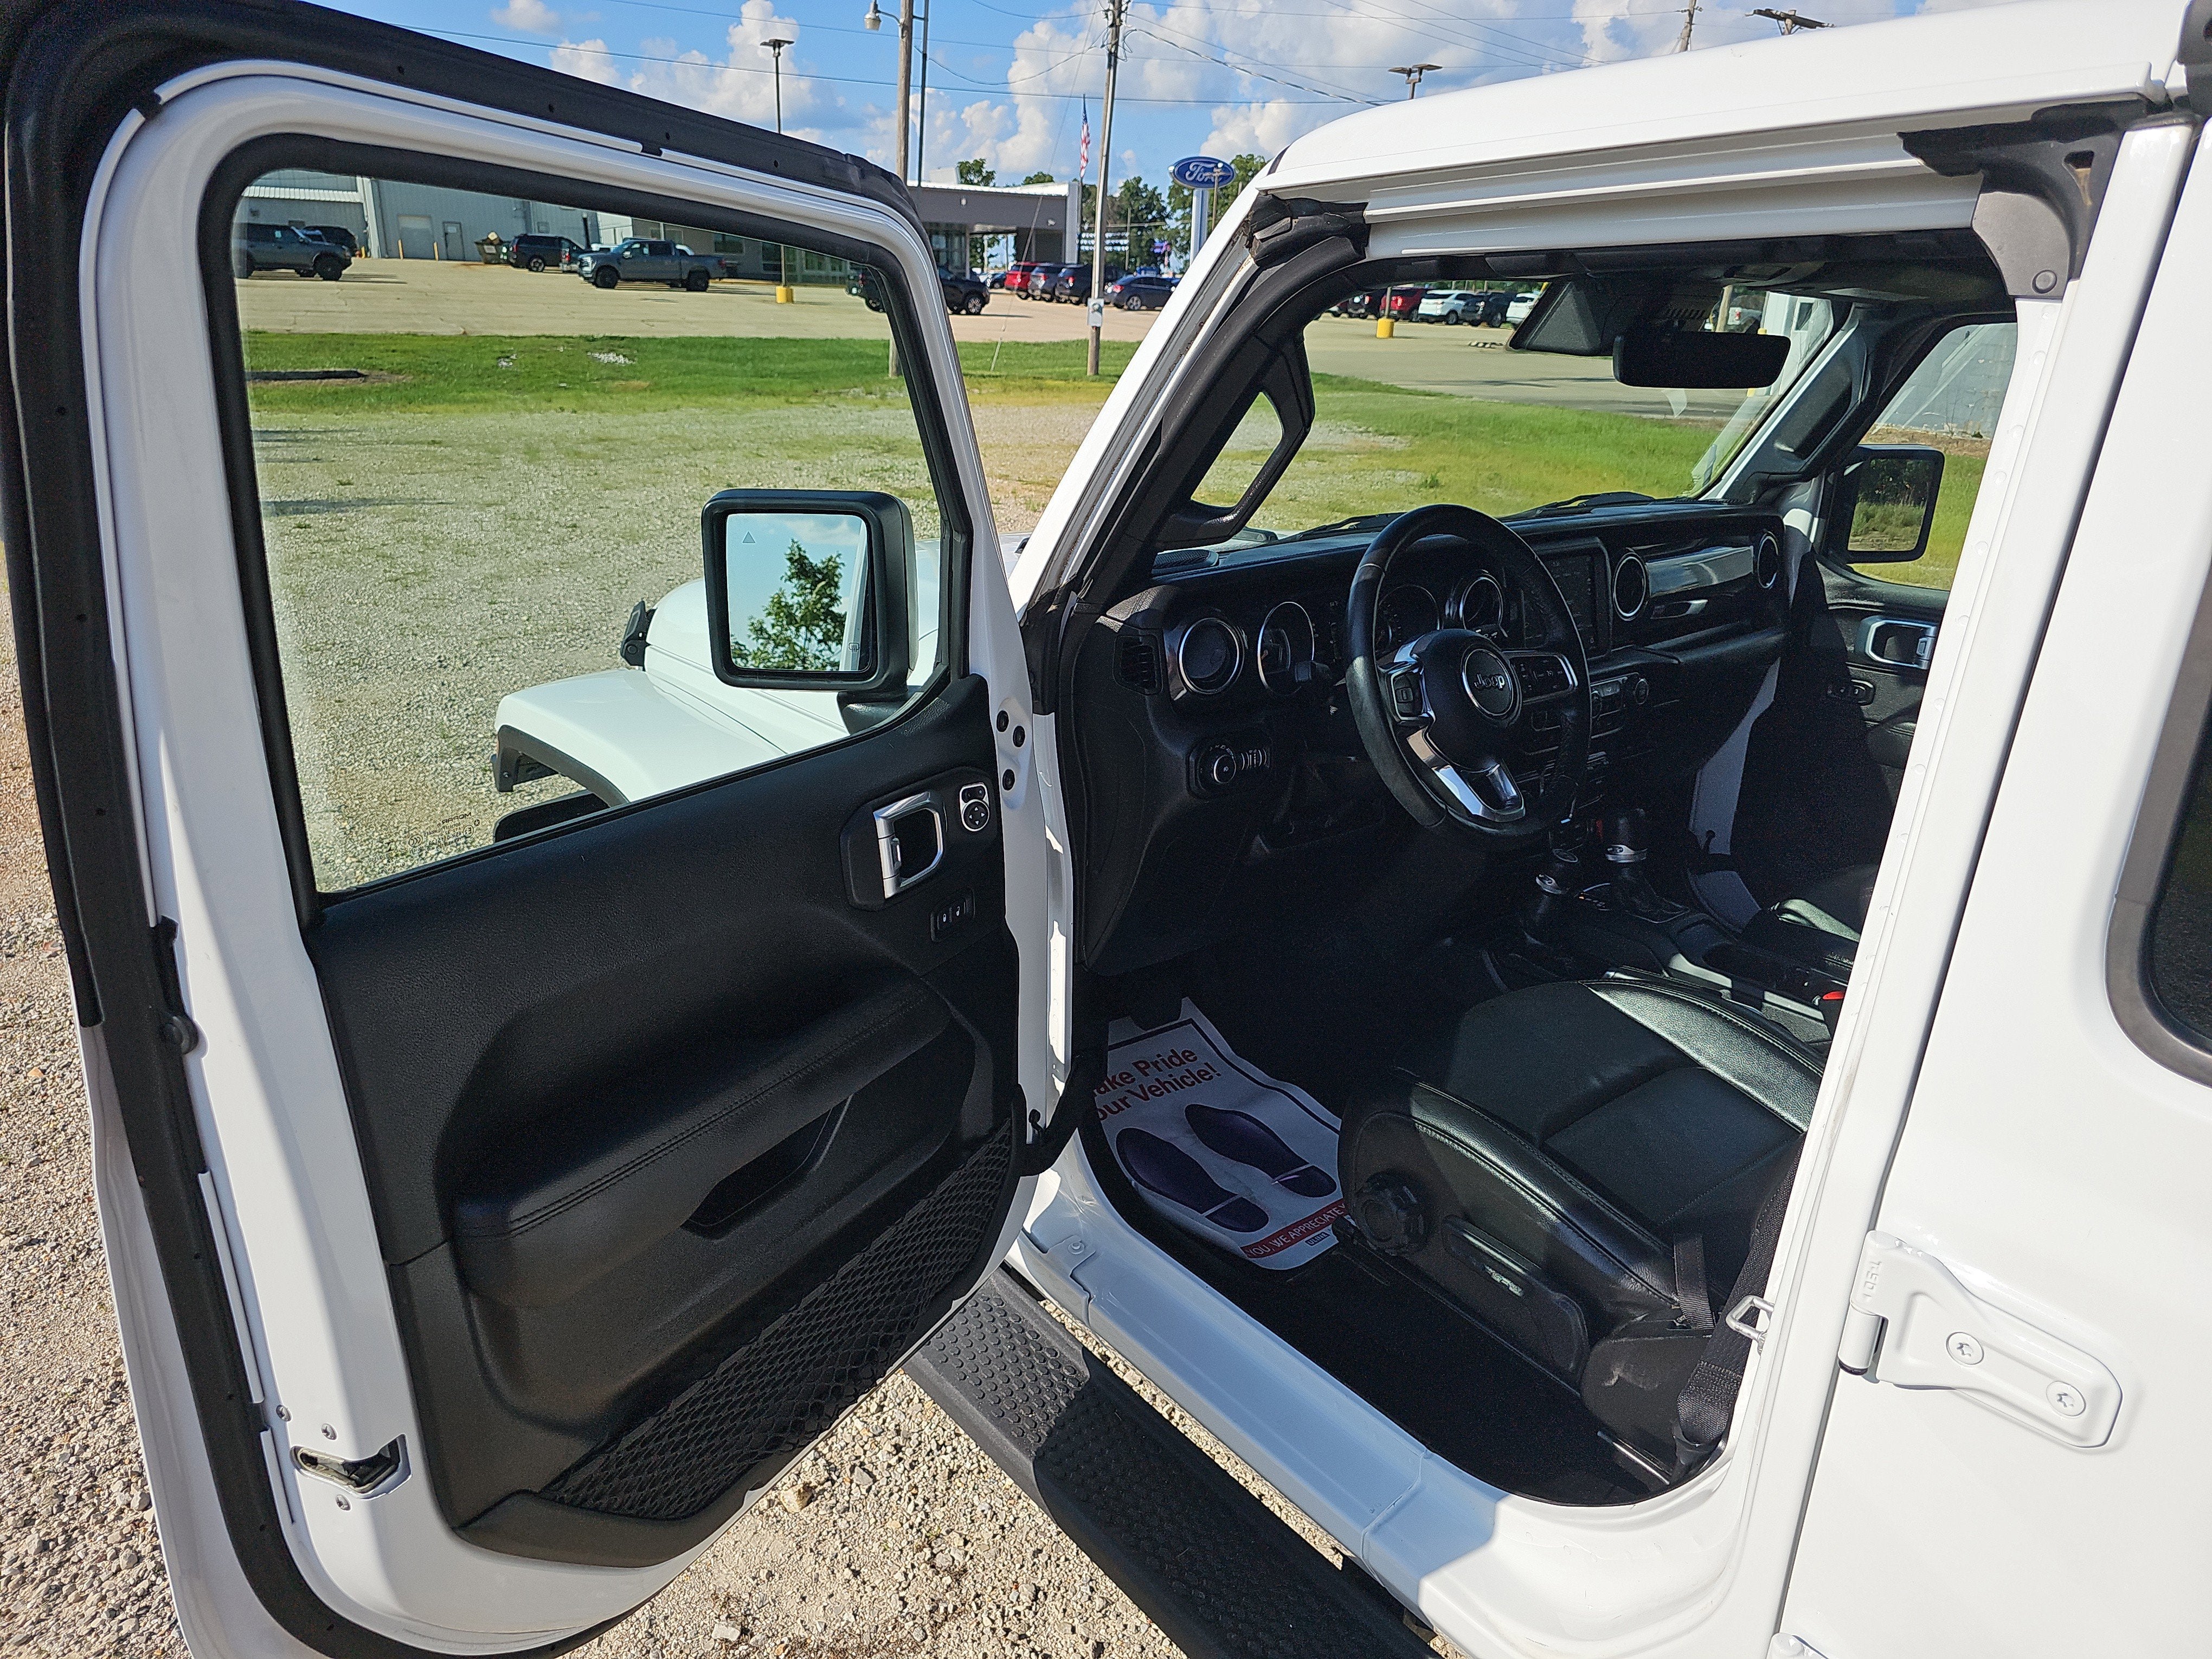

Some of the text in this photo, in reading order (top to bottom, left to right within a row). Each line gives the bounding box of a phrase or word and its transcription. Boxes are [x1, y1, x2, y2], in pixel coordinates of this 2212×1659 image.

[1474, 674, 1505, 689] Jeep
[1094, 1049, 1198, 1096] ake Pride
[1096, 1062, 1221, 1121] our Vehicle!
[1269, 1234, 1291, 1248] WE
[1288, 1206, 1345, 1240] APPRECIATE
